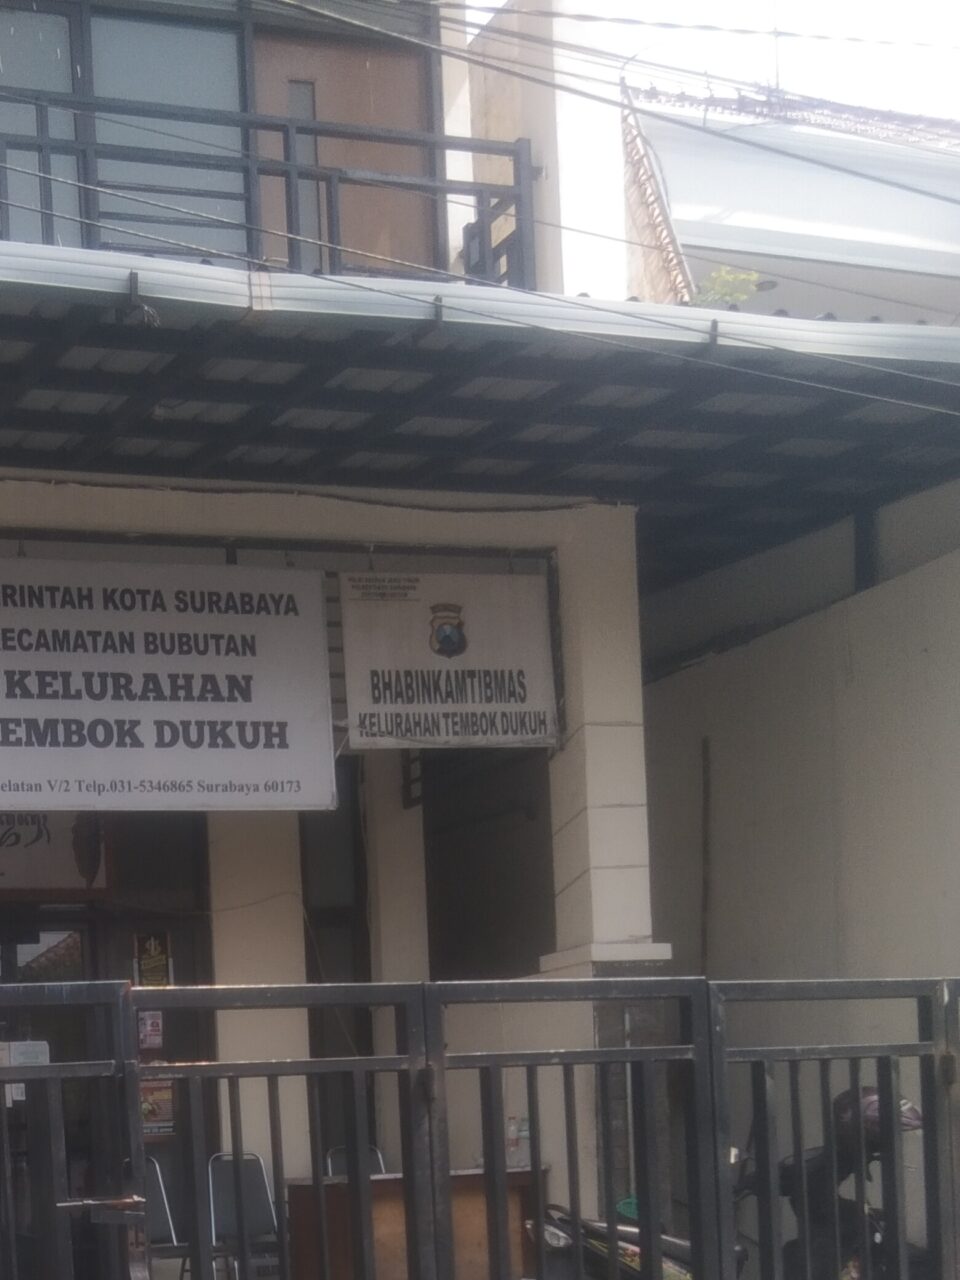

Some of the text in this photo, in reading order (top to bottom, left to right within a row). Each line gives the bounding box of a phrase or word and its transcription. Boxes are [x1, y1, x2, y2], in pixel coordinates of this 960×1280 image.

[102, 586, 167, 613] KOTA
[174, 589, 299, 617] SURABAYA
[143, 631, 257, 657] BUBUTAN
[4, 670, 253, 703] KELURAHAN
[370, 669, 527, 705] BHABINKAMTIBMAS
[154, 719, 289, 749] DUKUH
[358, 710, 548, 738] KELURAHAN TEMBOK DUKUH
[47, 778, 71, 793] V/2
[75, 778, 194, 796] Telp.031-5346865
[197, 779, 261, 796] Surabaya
[263, 779, 302, 794] 60173
